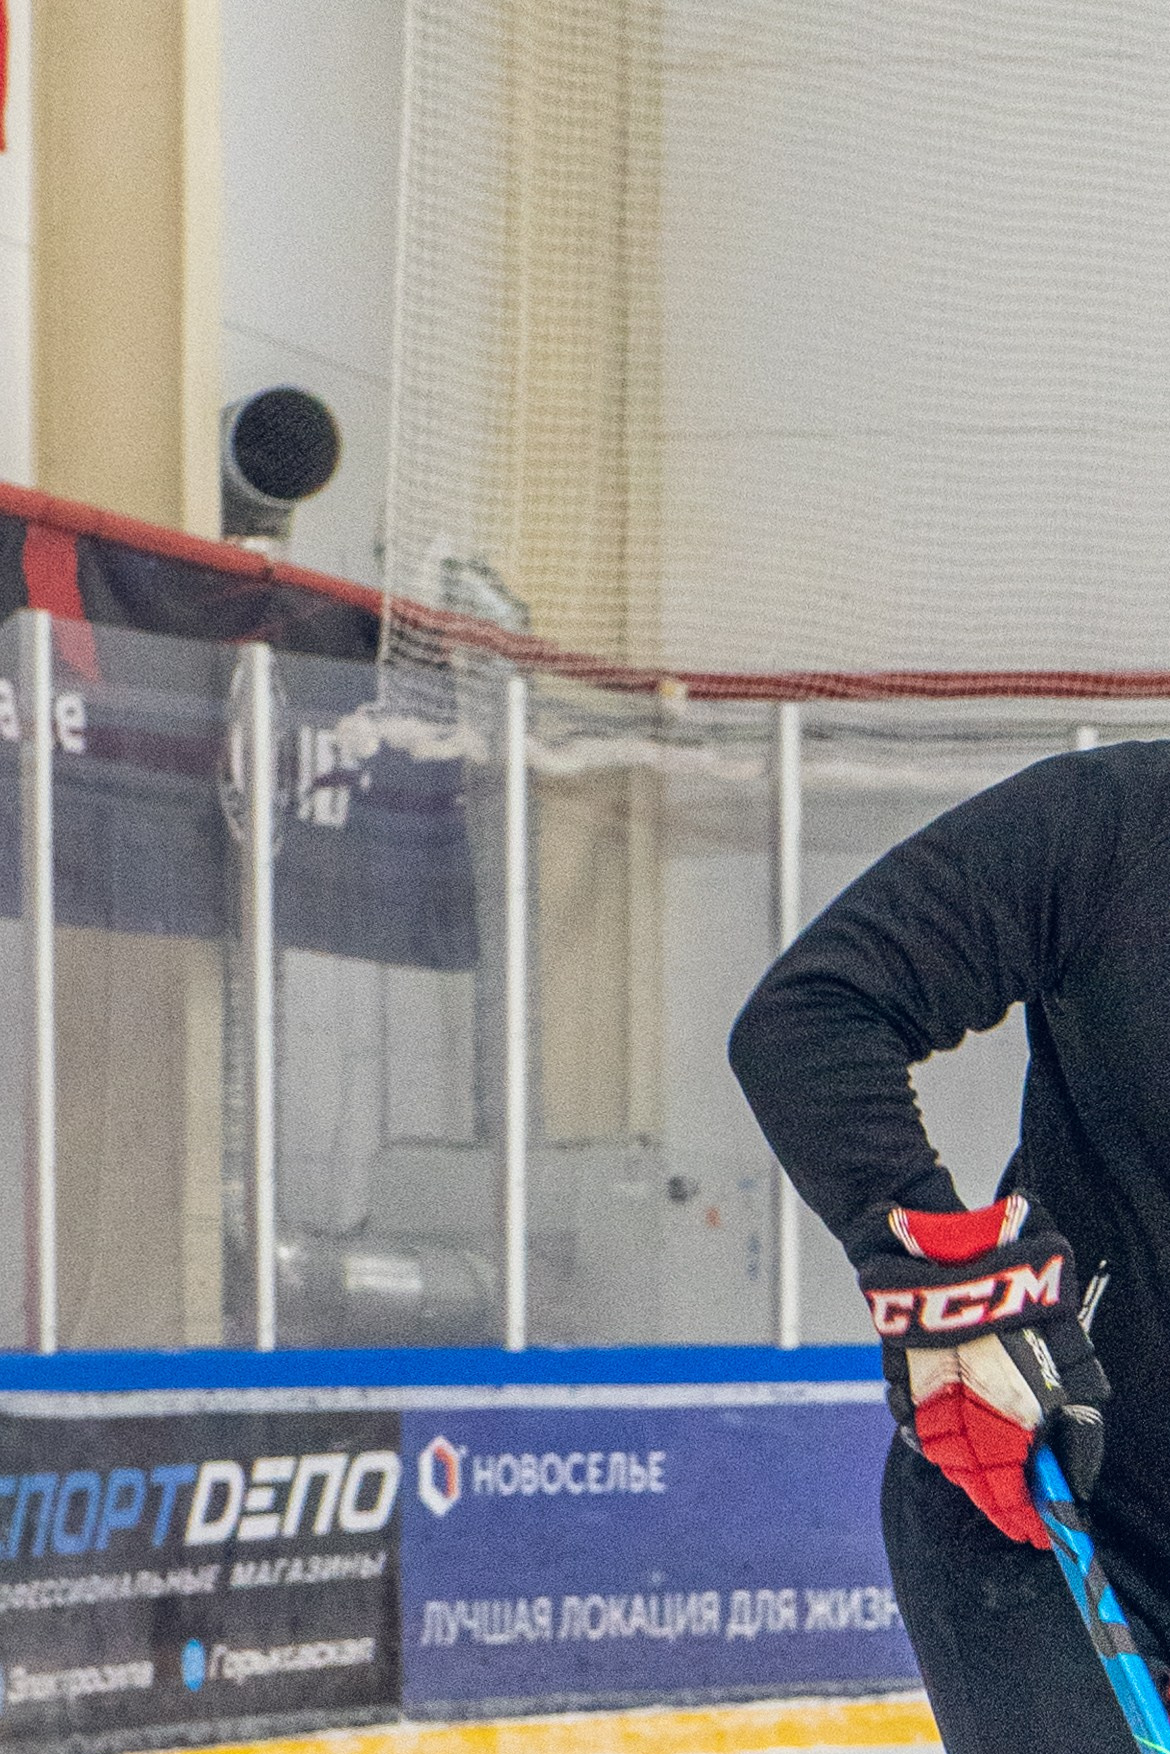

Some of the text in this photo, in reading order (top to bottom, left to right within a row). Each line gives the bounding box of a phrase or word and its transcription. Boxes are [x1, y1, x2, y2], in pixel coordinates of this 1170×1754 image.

[864, 1254, 1064, 1337] CCM
[473, 1450, 668, 1494] НОВОСЕЛЬЕ
[229, 1551, 387, 1589] МАГАЗИНЫ
[420, 1598, 553, 1647] ЛУЧШАЯ
[557, 1590, 723, 1644] ЛОКАЦИЯ
[726, 1588, 798, 1642] ДЛЯ
